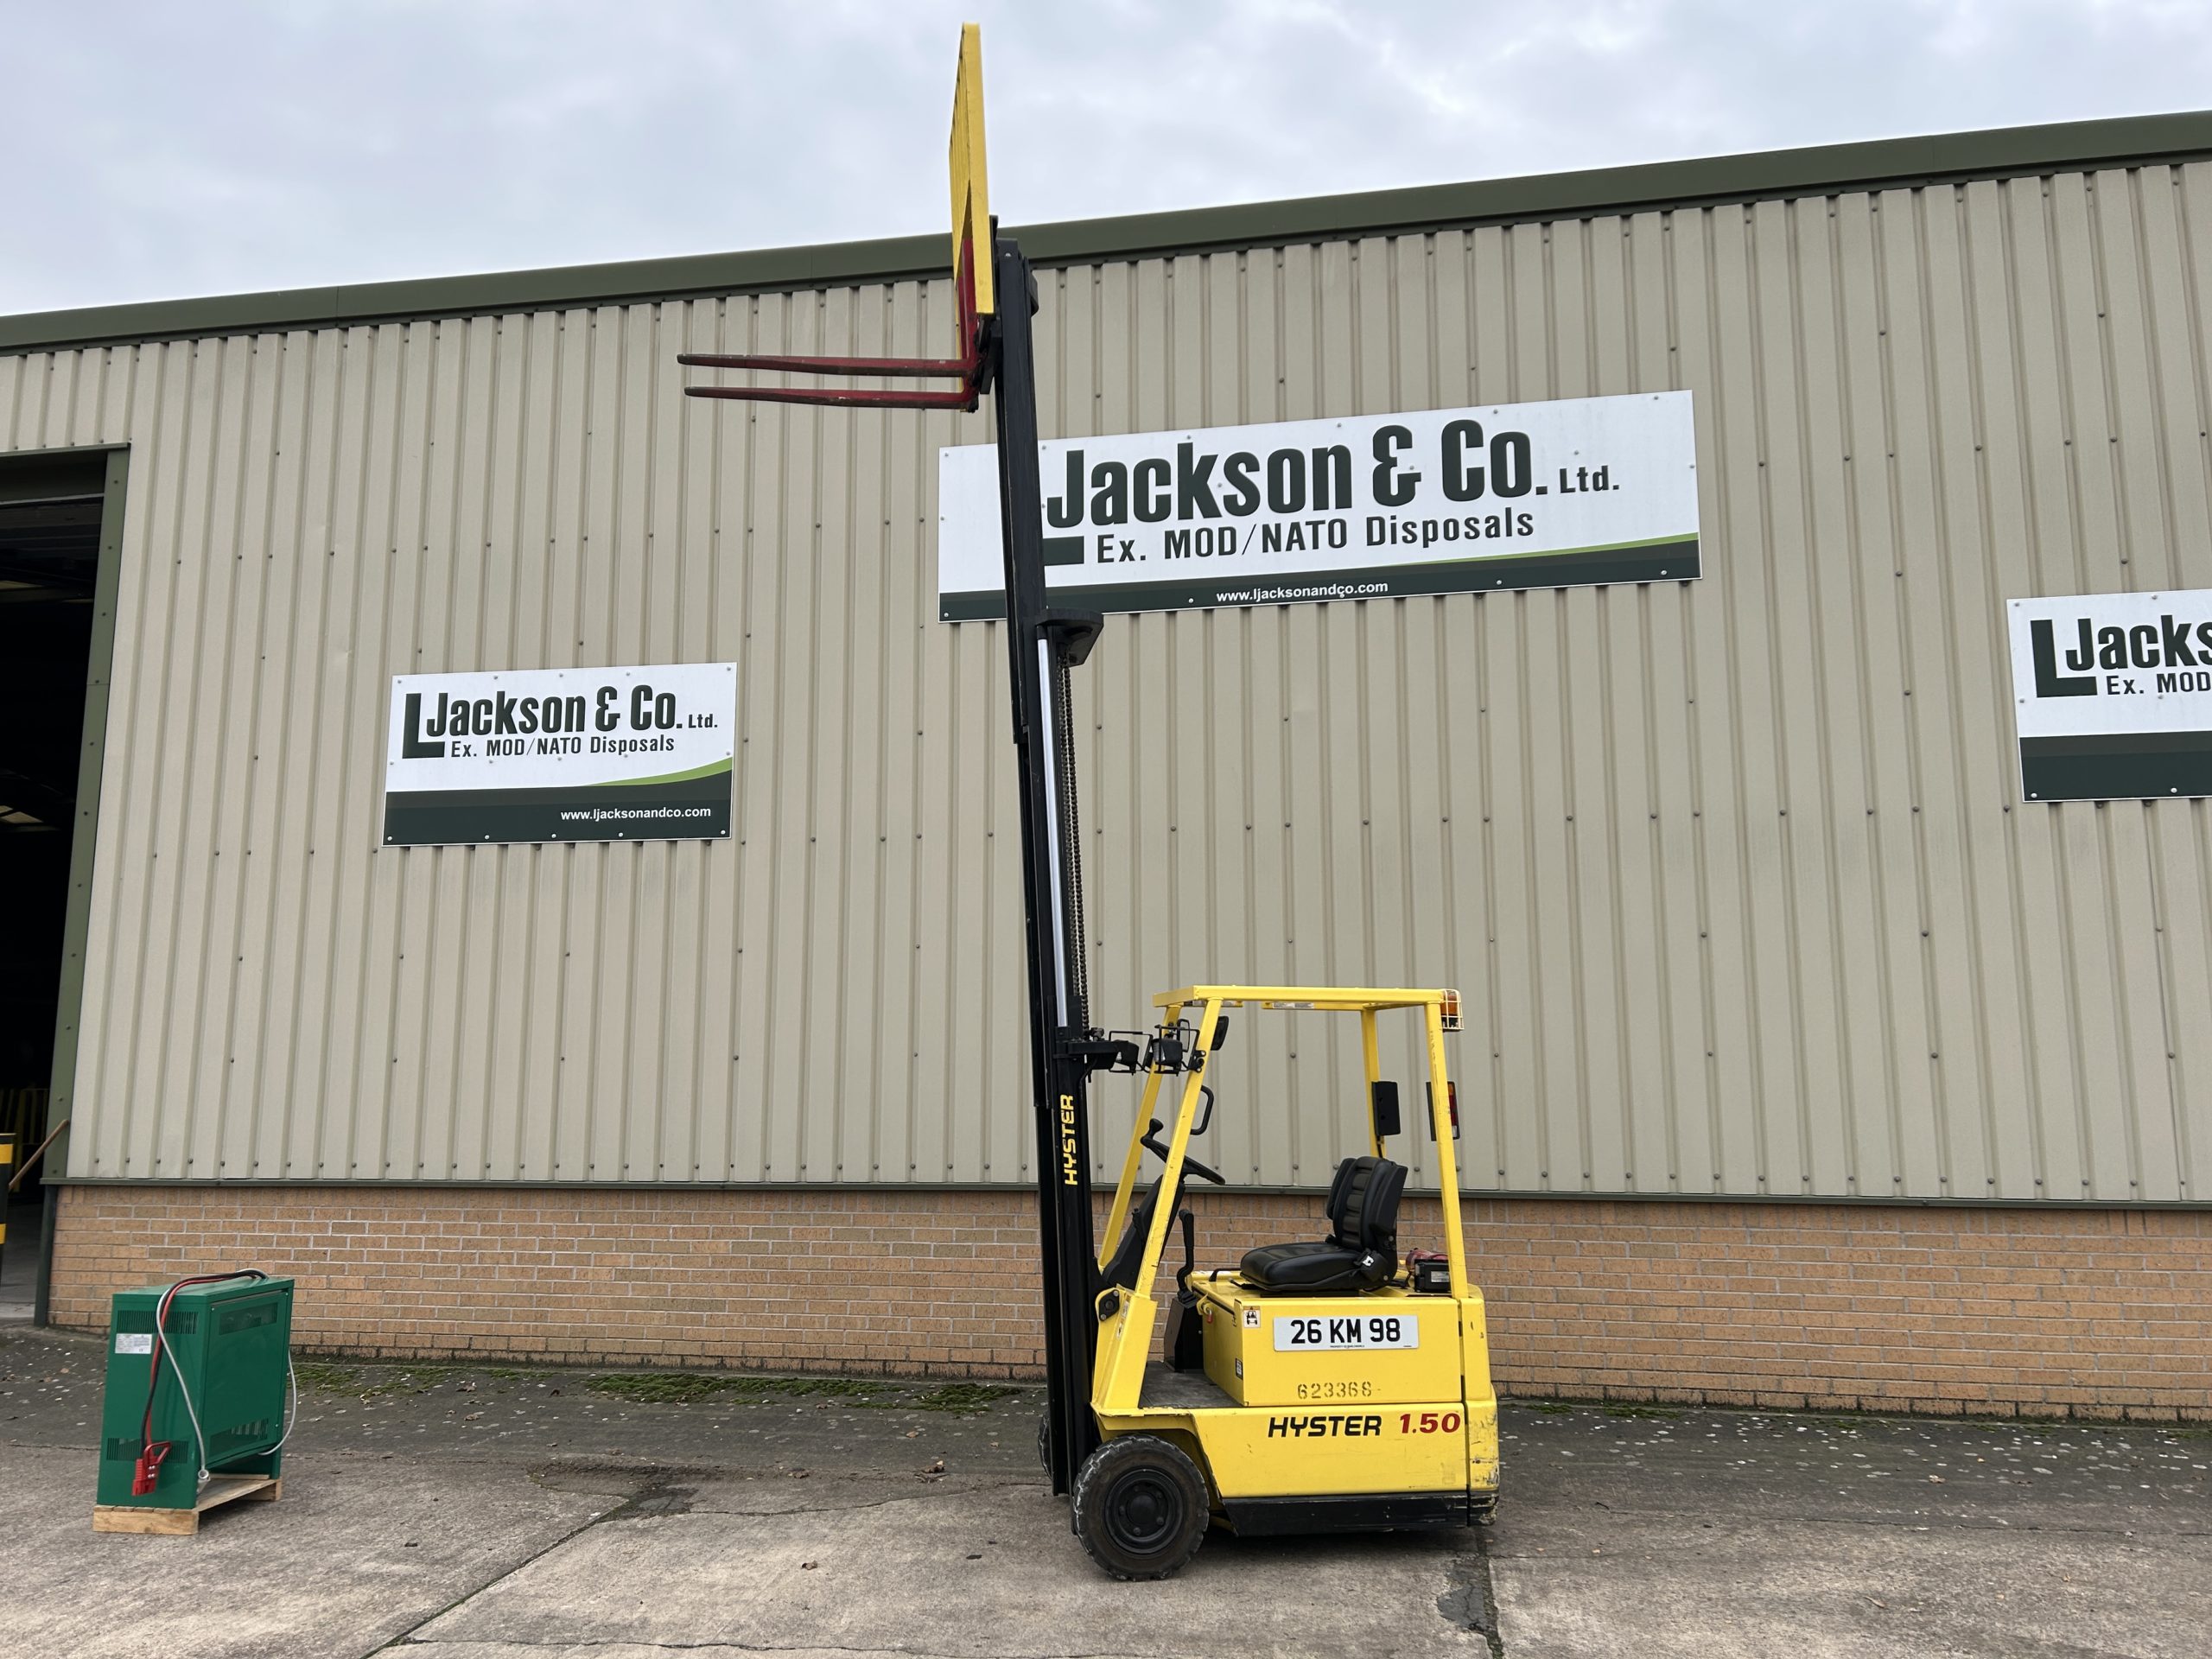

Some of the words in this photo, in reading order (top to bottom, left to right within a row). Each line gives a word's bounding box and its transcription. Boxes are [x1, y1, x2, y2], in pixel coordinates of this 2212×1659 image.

[1372, 424, 1421, 506] &
[1441, 419, 1548, 501] Co.
[1560, 465, 1619, 493] Ltd.
[1097, 534, 1146, 563] Ex.
[1164, 518, 1347, 560] MOD/NATO
[1366, 506, 1534, 548] Disposals
[1217, 582, 1389, 602] www.ljacksonandco.com
[2106, 675, 2145, 696] Ex.
[594, 685, 620, 732] &
[630, 684, 683, 731] Co.
[688, 714, 718, 729] Ltd.
[450, 741, 477, 758] Ex.
[486, 736, 582, 757] MOD/NATO
[590, 734, 675, 755] Disposals
[561, 807, 711, 822] www.ljacksonandco.com
[1060, 1094, 1077, 1185] HYSTER
[1290, 1319, 1322, 1344] 26
[1330, 1319, 1362, 1344] KM
[1369, 1318, 1401, 1342] 98
[1268, 1415, 1382, 1438] HYSTER
[1399, 1413, 1461, 1434] 1.50
